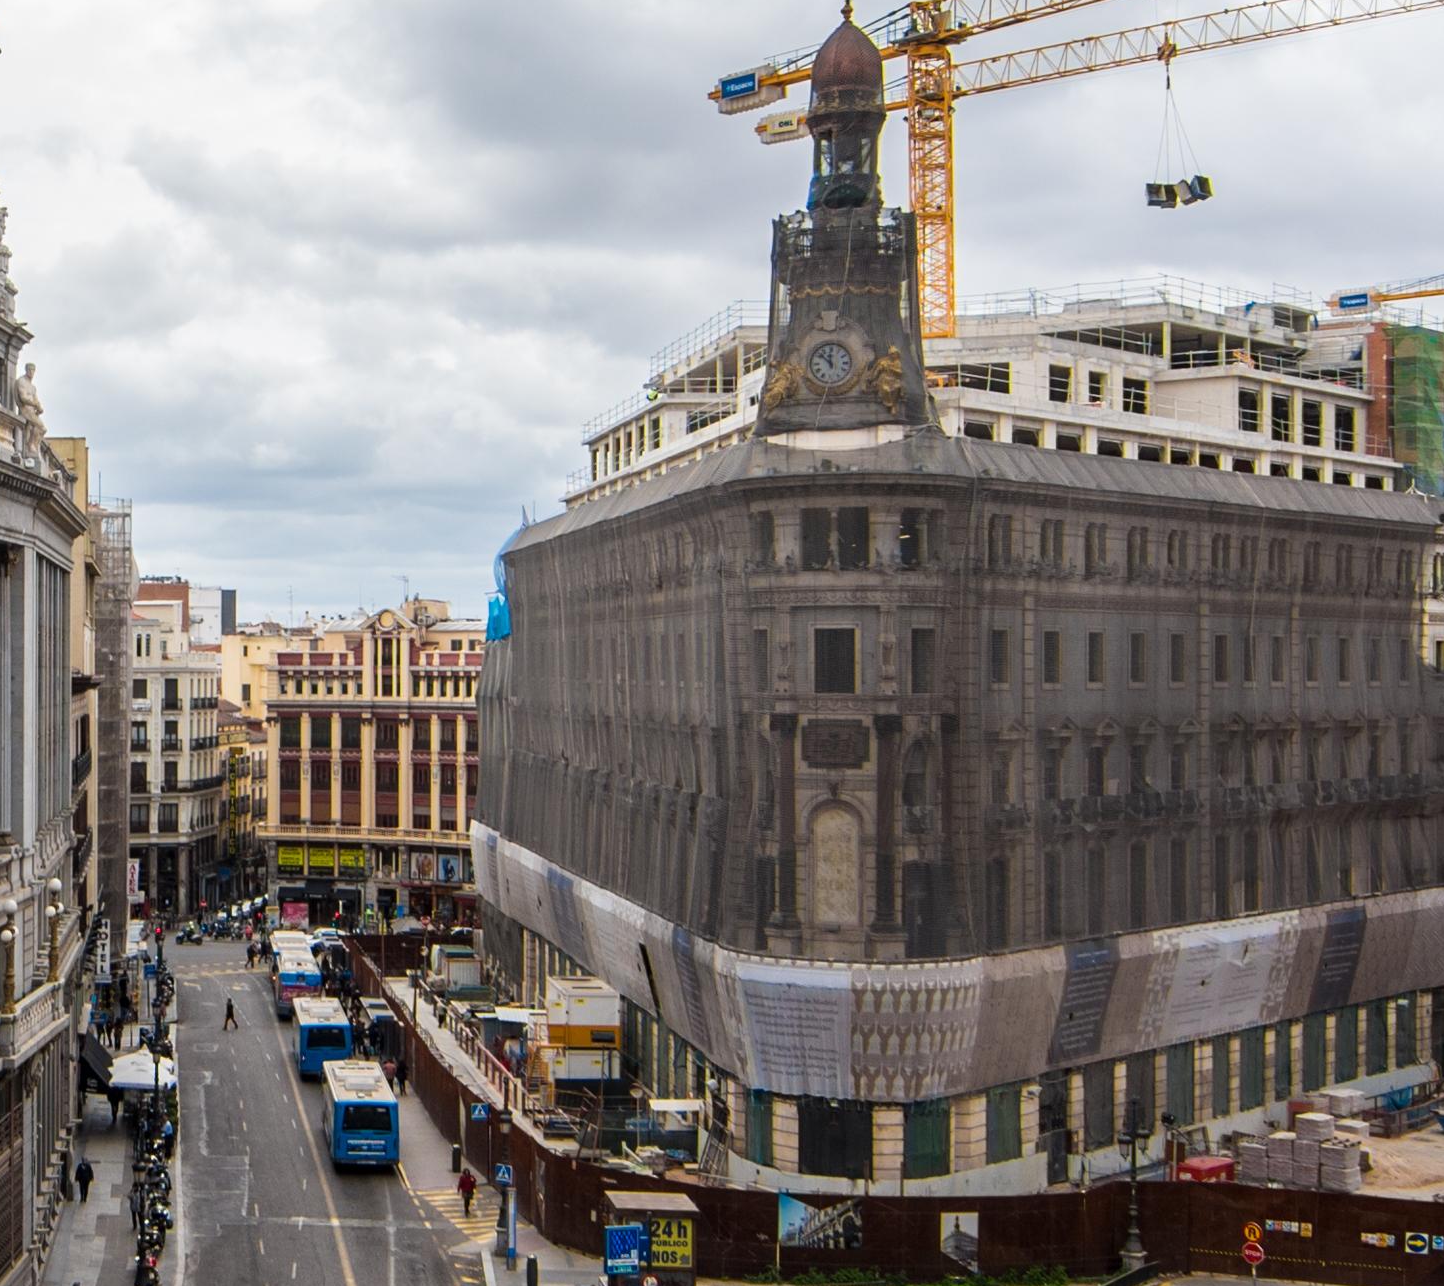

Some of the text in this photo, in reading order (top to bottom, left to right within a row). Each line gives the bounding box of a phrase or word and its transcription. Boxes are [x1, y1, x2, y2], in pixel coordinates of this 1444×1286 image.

[99, 919, 109, 974] HOTEL
[651, 1220, 673, 1239] 24
[1244, 1248, 1261, 1258] STOP
